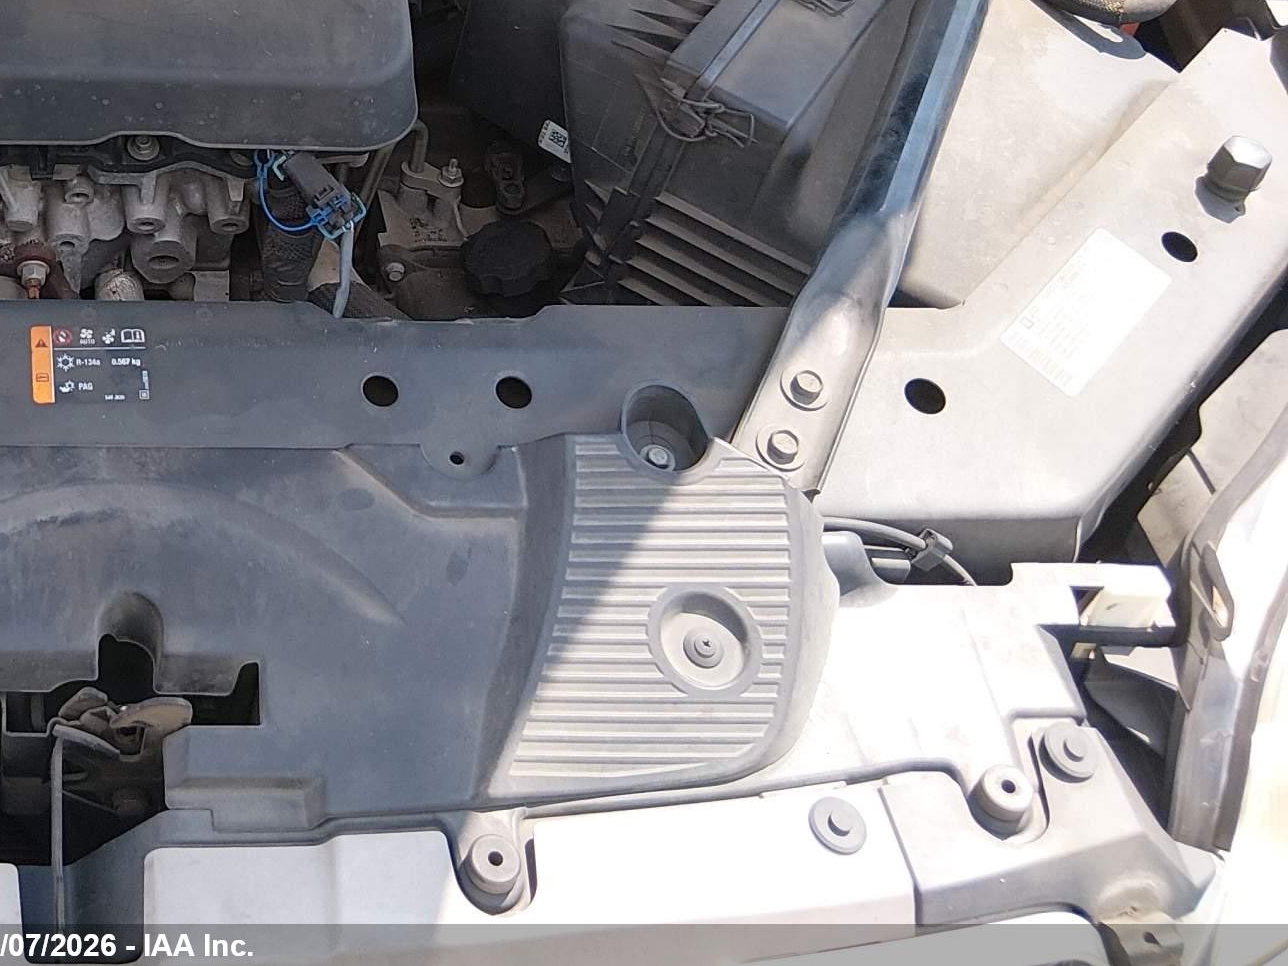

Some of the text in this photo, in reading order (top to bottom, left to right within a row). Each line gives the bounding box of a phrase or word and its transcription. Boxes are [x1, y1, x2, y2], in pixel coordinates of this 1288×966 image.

[76, 358, 101, 366] R-134a
[131, 358, 141, 367] kg
[78, 382, 93, 391] PAG
